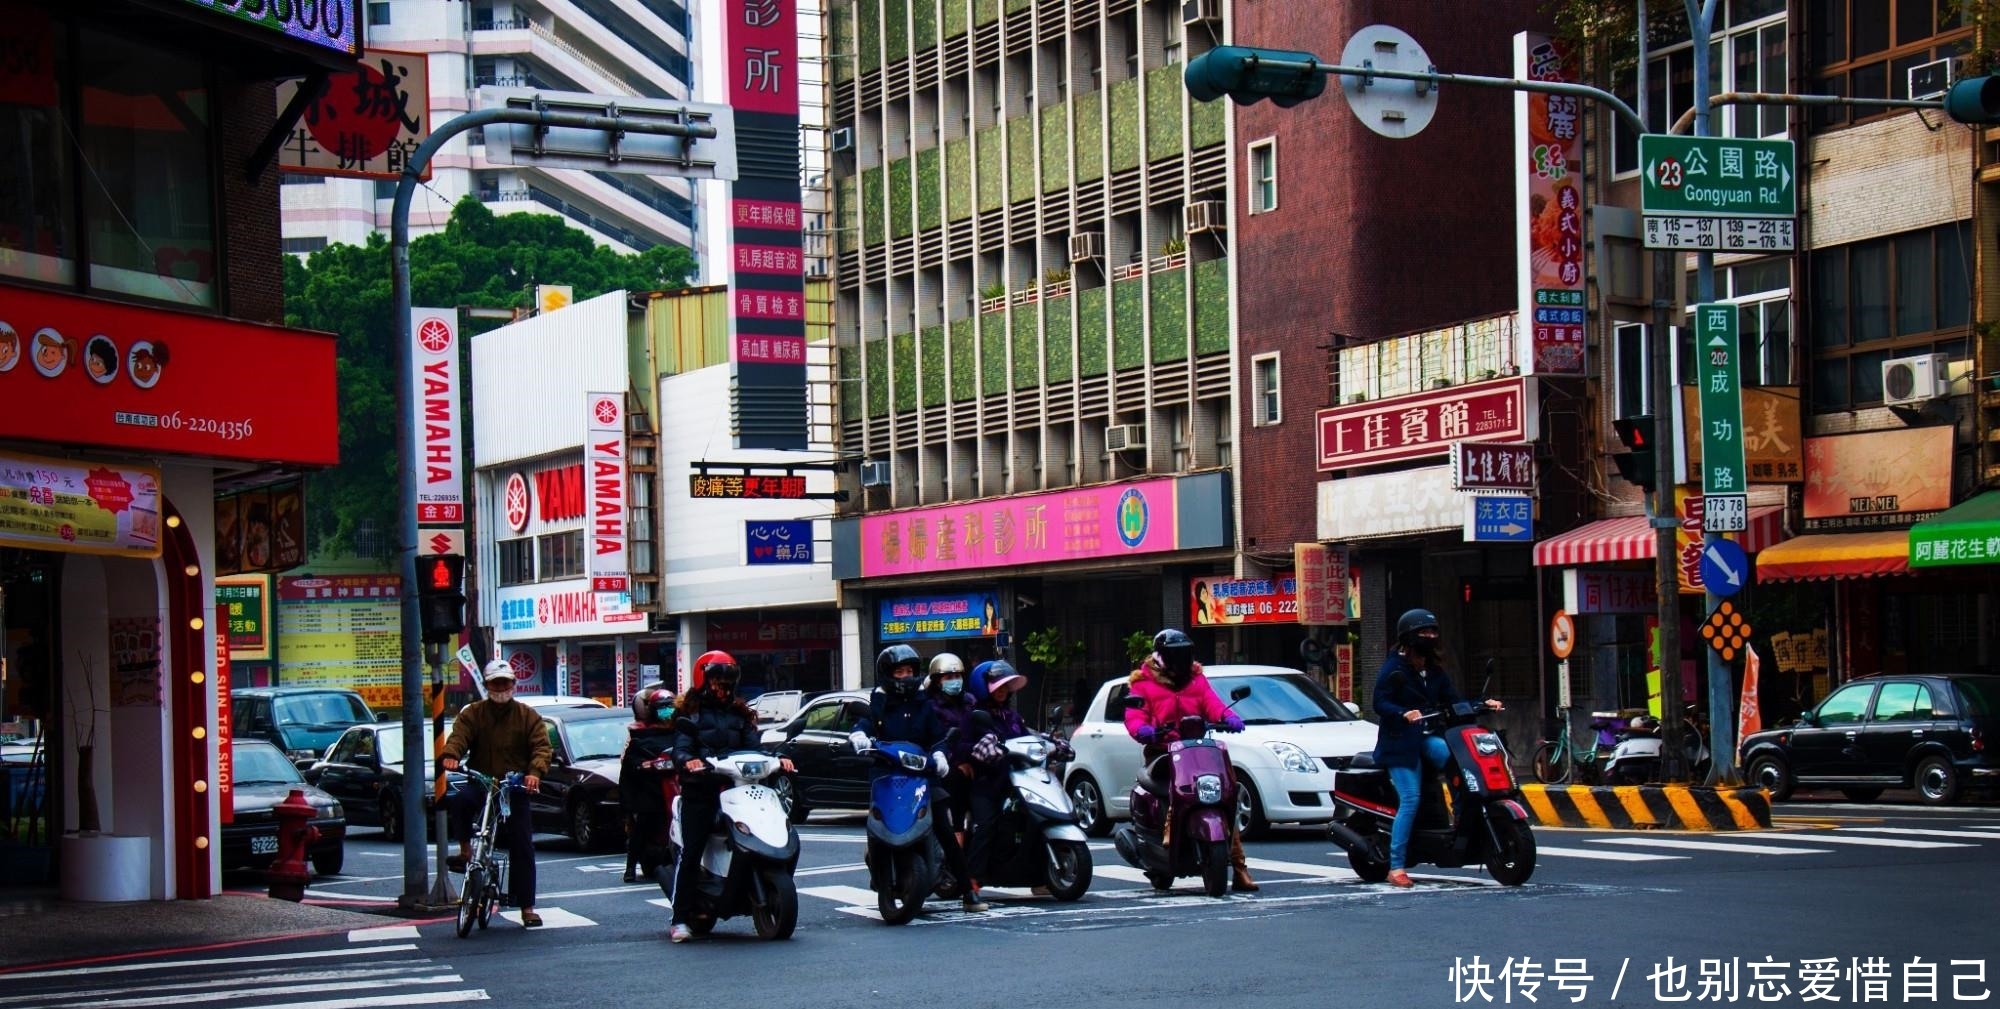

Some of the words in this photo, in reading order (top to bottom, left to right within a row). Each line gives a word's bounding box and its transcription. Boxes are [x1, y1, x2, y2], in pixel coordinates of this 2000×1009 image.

[284, 128, 420, 173] 牛排館
[1660, 161, 1682, 187] 23
[1684, 147, 1779, 180] 公園路
[1684, 184, 1752, 207] Gongyuan
[1759, 187, 1781, 204] Rd.
[738, 204, 797, 228] 更年期保健
[1647, 219, 1659, 233] 南
[1663, 219, 1681, 232] 115
[1696, 219, 1713, 232] 137
[1727, 220, 1744, 233] 139
[1759, 220, 1777, 234] 221
[1780, 221, 1790, 234] 北
[1666, 233, 1679, 246] 76
[1696, 234, 1714, 246] 120
[1727, 235, 1744, 247] 126
[1759, 235, 1777, 248] 176
[739, 248, 798, 271] 乳房超音波
[740, 293, 799, 316] 骨質檢查
[1707, 309, 1728, 332] 西
[741, 338, 770, 360] 高血壓
[773, 338, 801, 361] 糖尿病
[1709, 350, 1728, 366] 202
[160, 410, 253, 441] 06-2204356
[423, 360, 452, 485] YAMAHA
[1483, 410, 1498, 420] TEL
[1326, 400, 1471, 458] 上佳賓館
[1709, 370, 1734, 490] 成功路
[1464, 450, 1532, 483] 上佳賓館
[593, 440, 622, 555] YAMAHA
[1708, 498, 1726, 512] 173
[1729, 498, 1743, 512] 78
[423, 505, 457, 520] 金初
[1477, 501, 1529, 521] 洗衣店
[750, 525, 792, 541] 心心
[1706, 517, 1725, 530] 141
[1730, 517, 1744, 530] 58
[775, 543, 810, 561] 藥局
[598, 579, 622, 589] 金初
[1302, 547, 1325, 623] 機車修理
[1325, 548, 1345, 611] 在此巷內
[550, 591, 598, 625] YAMAHA
[229, 620, 256, 633] 活動
[214, 633, 226, 671] RED
[216, 675, 227, 710] SUN
[218, 713, 228, 750] TEA
[218, 753, 230, 794] SHOP
